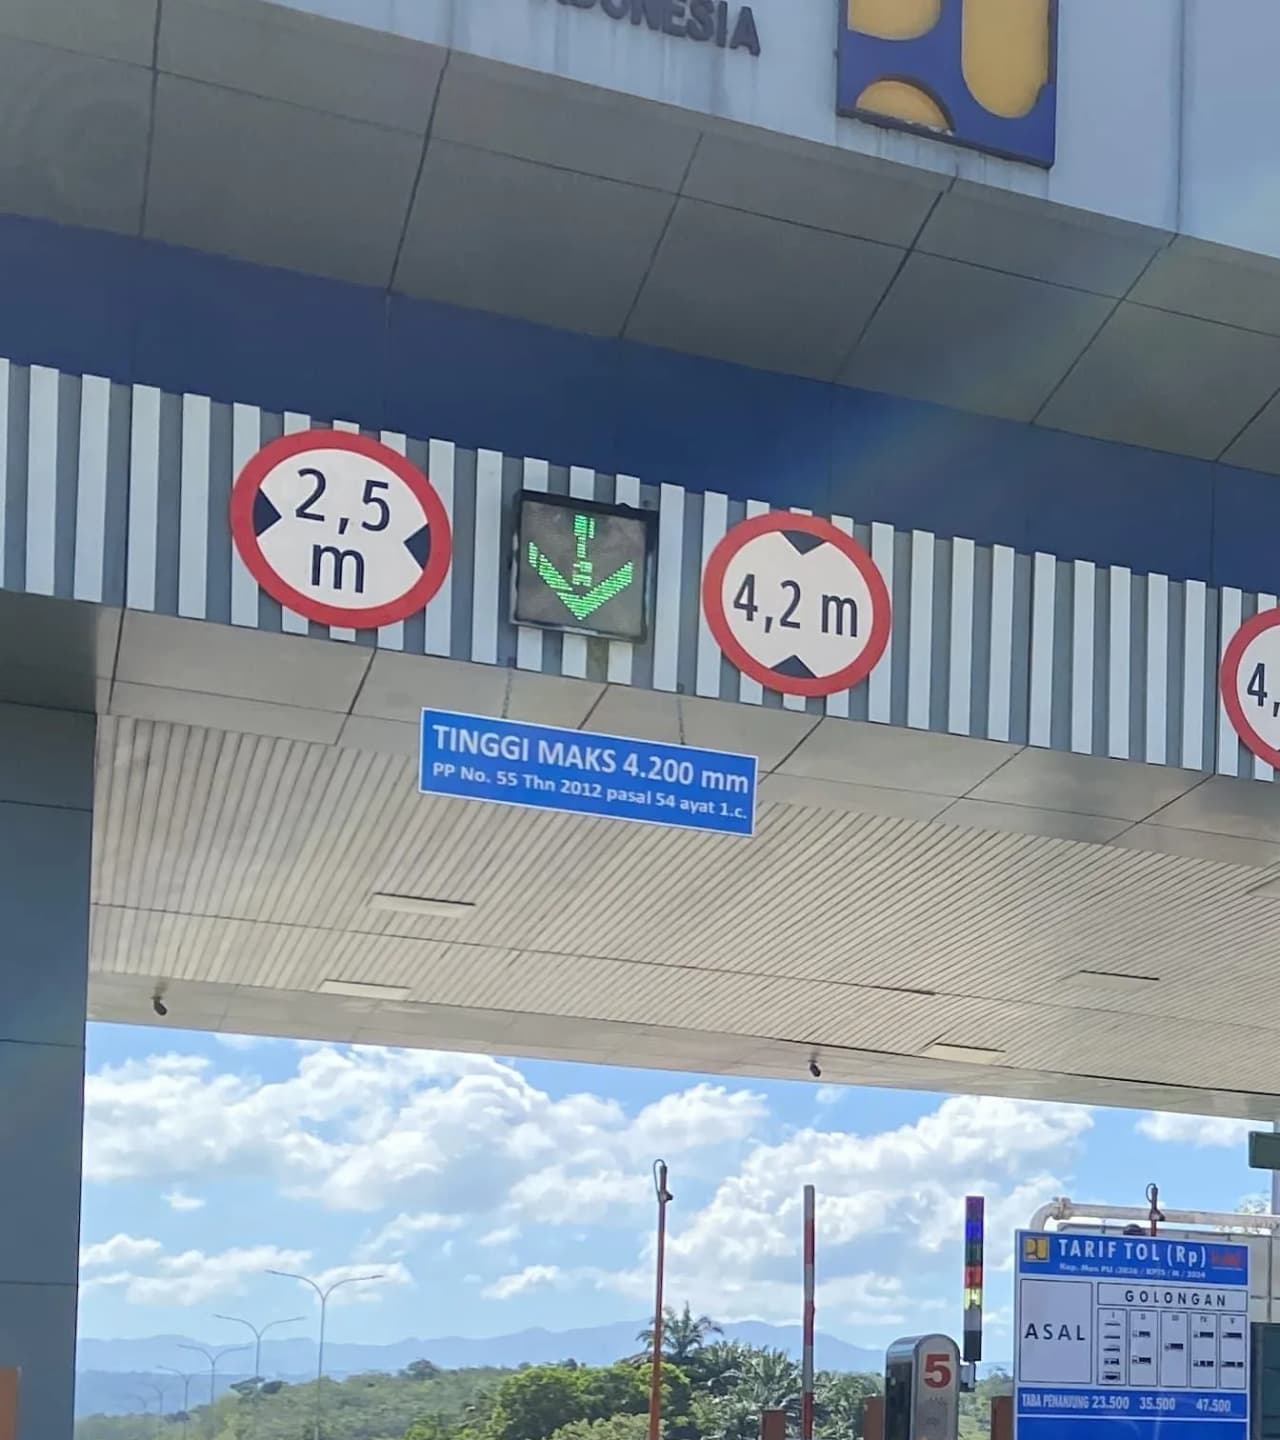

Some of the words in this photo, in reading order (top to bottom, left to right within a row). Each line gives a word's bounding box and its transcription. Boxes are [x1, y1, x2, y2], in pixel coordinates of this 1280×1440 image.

[553, 0, 761, 57] NESIA
[295, 467, 391, 533] 2,5
[311, 537, 366, 594] m
[733, 572, 804, 630] 4,2
[820, 592, 859, 640] m
[432, 724, 529, 762] TINGGI
[538, 739, 617, 773] MAKS
[623, 753, 693, 784] 4.200
[701, 769, 748, 793] mm
[433, 762, 455, 777] PP
[460, 766, 491, 783] No.
[496, 771, 517, 786] 55
[522, 774, 555, 792] Thn
[560, 779, 602, 798] 2012
[606, 784, 651, 805] pasal
[655, 793, 675, 808] 54
[680, 797, 715, 818] ayat
[1058, 1239, 1116, 1260] TARIF
[1125, 1242, 1160, 1261] TOL
[1167, 1245, 1207, 1267] (Rp)
[1125, 1290, 1225, 1307] GOLONGAN
[1025, 1323, 1085, 1342] ASAL
[924, 1354, 952, 1389] 5
[1092, 1395, 1129, 1409] 23.500
[1139, 1397, 1175, 1411] 35.500
[1196, 1398, 1231, 1413] 47.500
